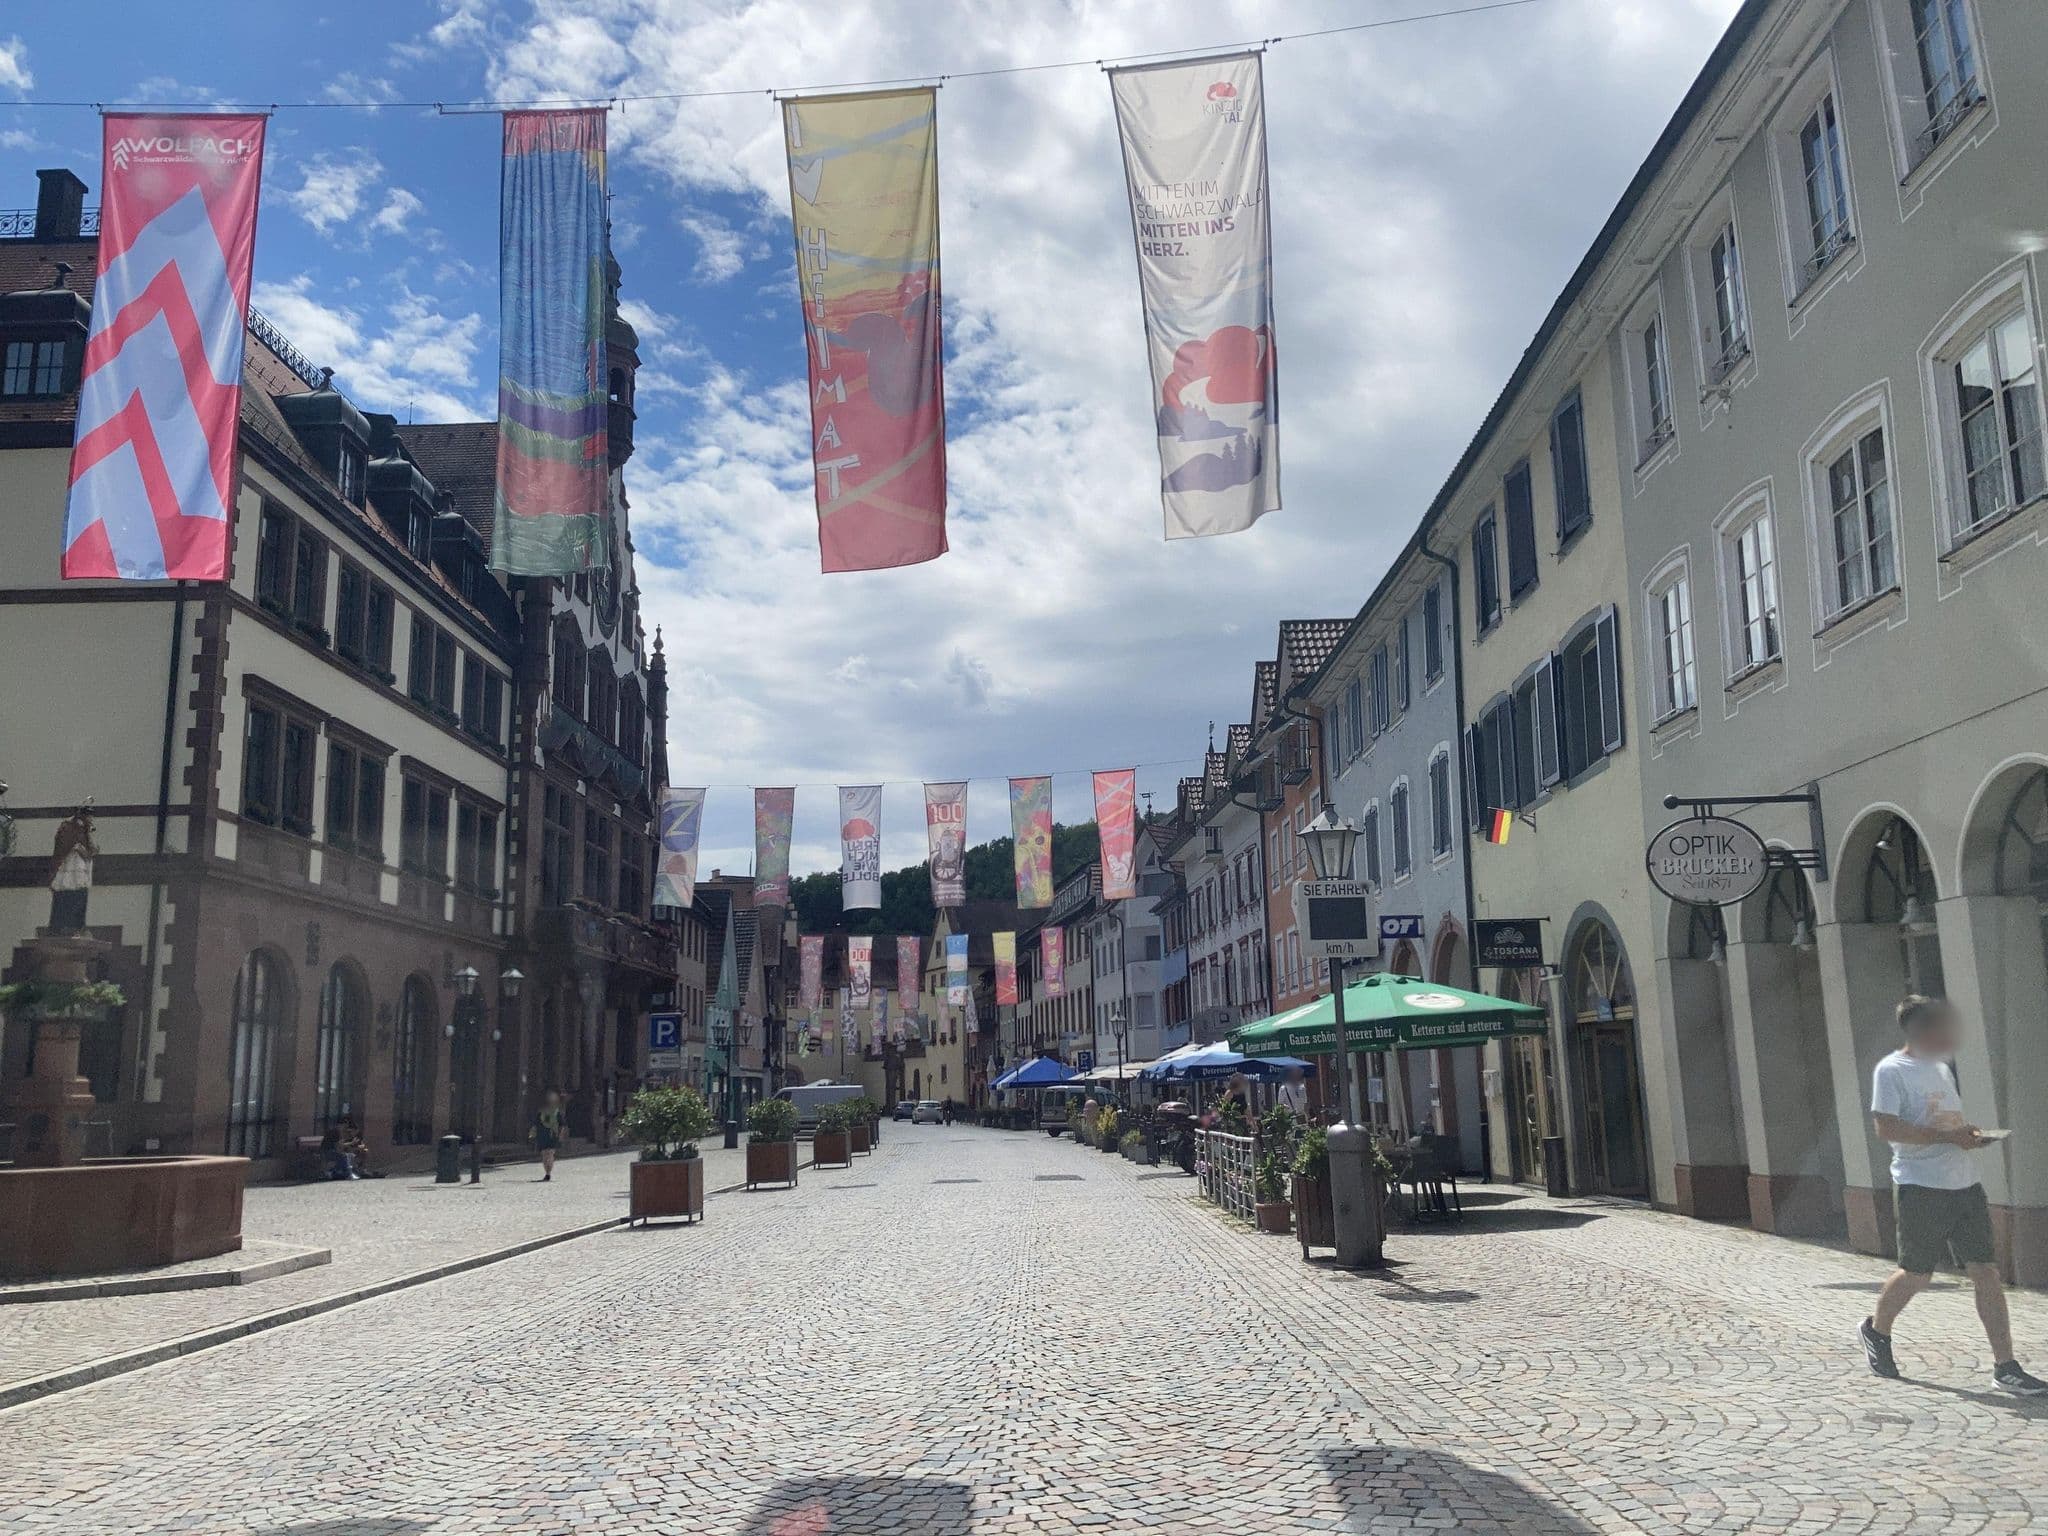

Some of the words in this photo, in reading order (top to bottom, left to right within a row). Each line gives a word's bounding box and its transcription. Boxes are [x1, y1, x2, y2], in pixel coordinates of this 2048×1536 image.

[1221, 112, 1244, 124] TAL
[1134, 182, 1195, 201] MITTEN
[1200, 180, 1219, 195] IM
[1136, 186, 1264, 220] SCHWARZWALD
[1139, 221, 1200, 239] MITTEN
[1205, 216, 1235, 235] INS
[1142, 242, 1190, 257] HERZ.
[931, 803, 963, 823] 100
[1669, 835, 1736, 856] OPTIK
[1661, 857, 1754, 876] BRUCKER
[1303, 884, 1322, 896] SIE
[1325, 883, 1370, 896] FAHREN
[1326, 942, 1354, 954] km/h
[1493, 946, 1539, 955] TOSCANA
[656, 1020, 675, 1044] P
[1289, 1033, 1310, 1046] Ganz
[1312, 1030, 1337, 1043] schön
[1375, 1026, 1395, 1038] hier.
[1411, 1023, 1445, 1037] Ketterer
[1447, 1021, 1465, 1034] sind
[1467, 1021, 1504, 1034] netterer.
